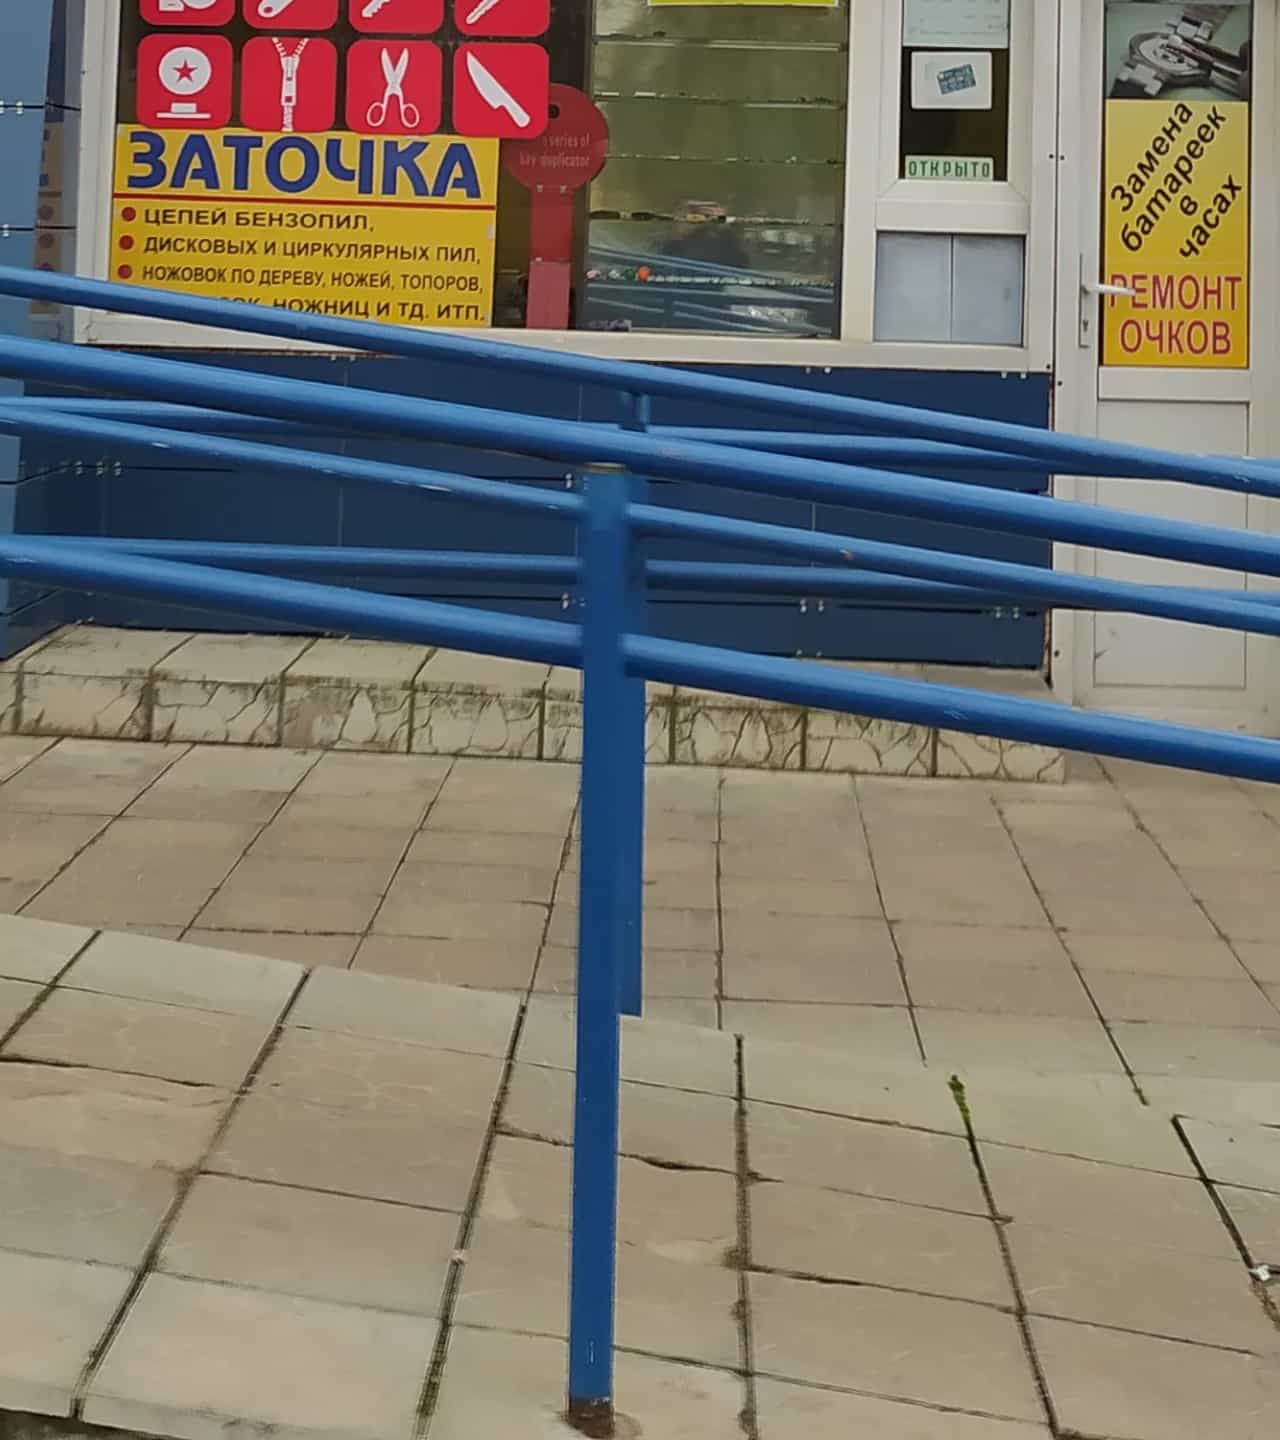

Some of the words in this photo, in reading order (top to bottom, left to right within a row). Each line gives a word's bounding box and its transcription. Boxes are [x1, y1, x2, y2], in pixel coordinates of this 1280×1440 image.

[127, 131, 481, 198] ЗАТОЧКА
[908, 160, 990, 178] ОТКРЫТО
[1111, 102, 1193, 212] Замена
[1121, 106, 1227, 252] батареек
[144, 208, 226, 226] ЦЕПЕЙ
[235, 210, 374, 232] БЕНЗОПИЛ,
[1179, 174, 1242, 258] часах
[1180, 195, 1198, 216] в
[144, 236, 256, 255] ДИСКОВЫХ
[264, 242, 276, 255] И
[283, 242, 429, 260] ЦИРКУЛЯРНЫХ
[436, 246, 480, 264] ПИЛ,
[142, 266, 226, 283] НОЖОВОК
[231, 268, 254, 284] ПО
[258, 269, 325, 288] ДЕРЕВУ,
[331, 271, 395, 290] НОЖЕЙ,
[400, 274, 483, 293] ТОПОРОВ,
[1110, 274, 1242, 310] РЕМОНТ
[273, 297, 369, 320] НОЖНИЦ
[376, 302, 389, 317] И
[1120, 319, 1231, 354] ОЧКОВ
